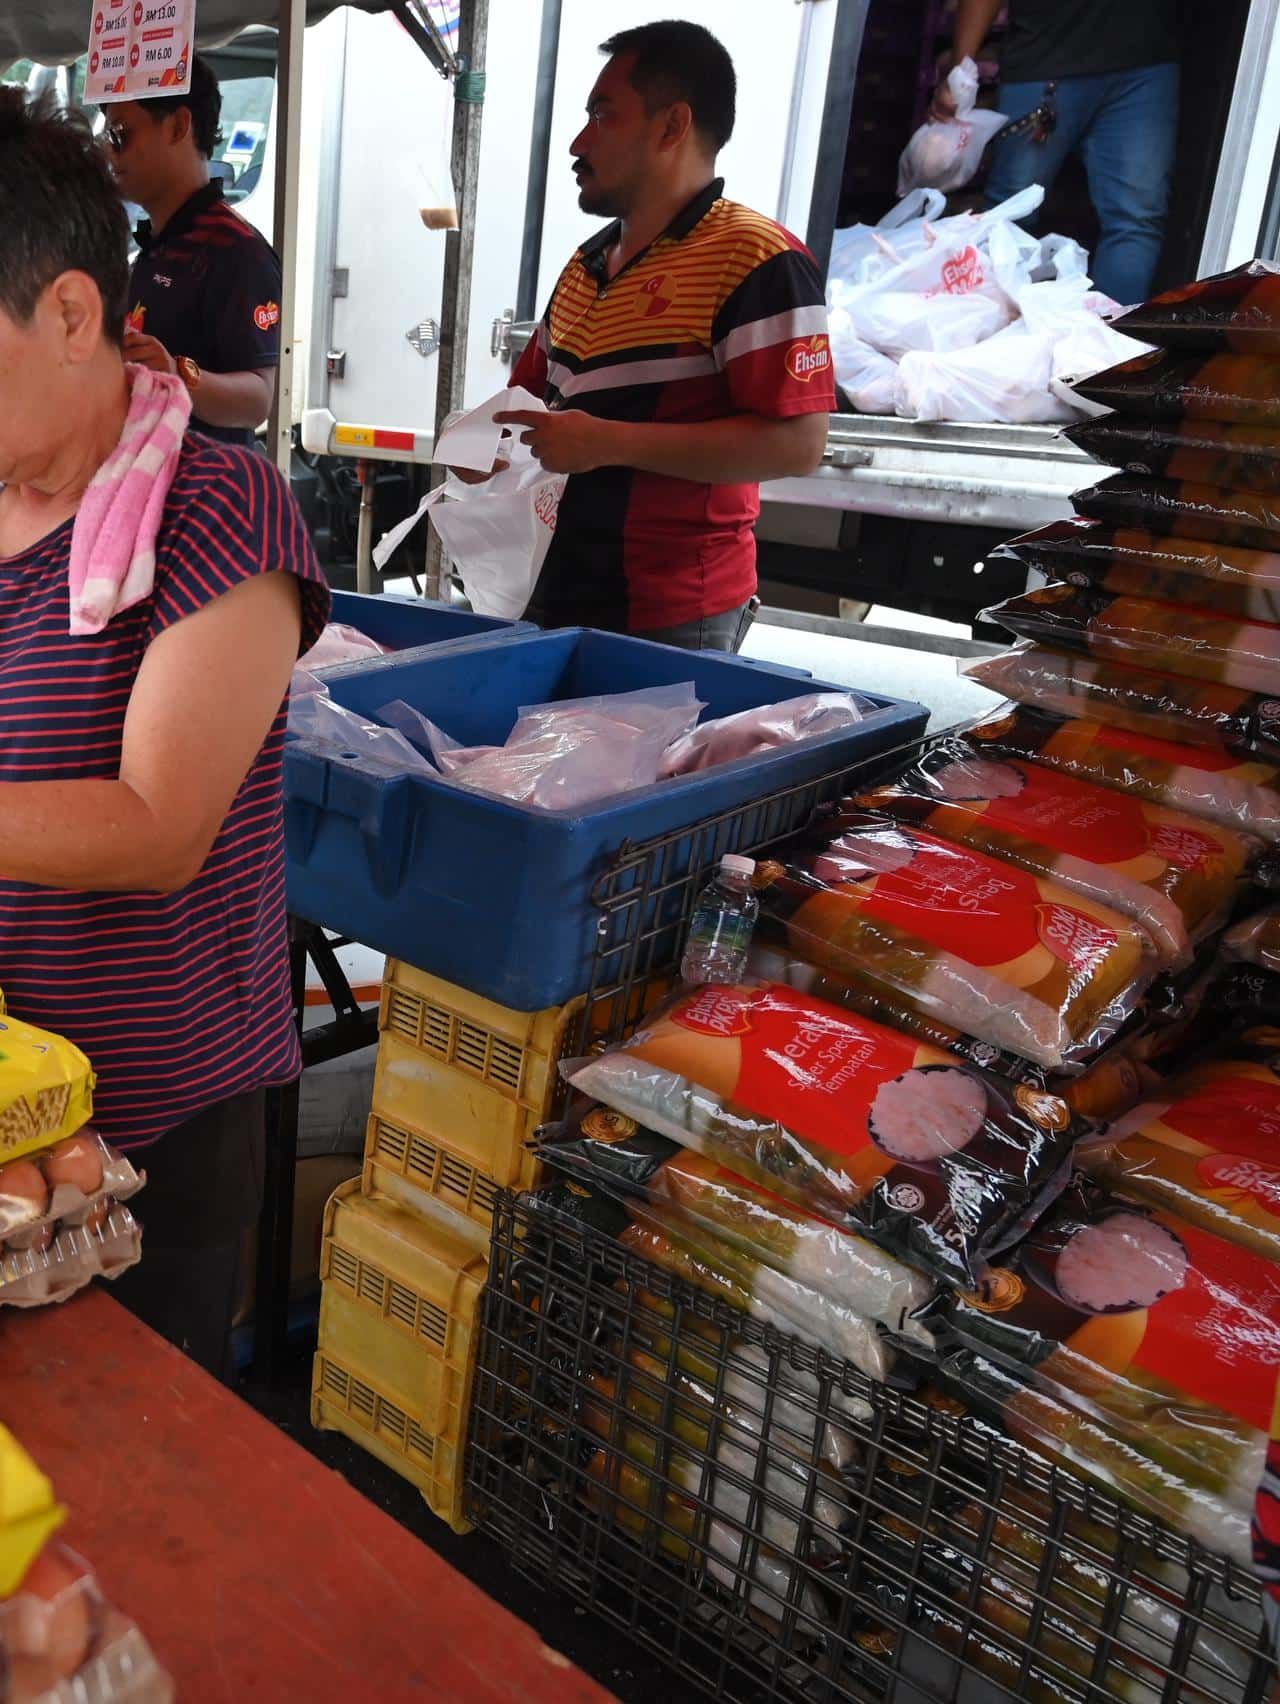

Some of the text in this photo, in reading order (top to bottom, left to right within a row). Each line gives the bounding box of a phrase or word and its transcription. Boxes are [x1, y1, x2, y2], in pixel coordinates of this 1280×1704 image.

[145, 47, 172, 61] RM 6.00
[794, 350, 828, 374] Ehsan
[1046, 905, 1077, 945] PKPS
[708, 996, 742, 1036] PKPS
